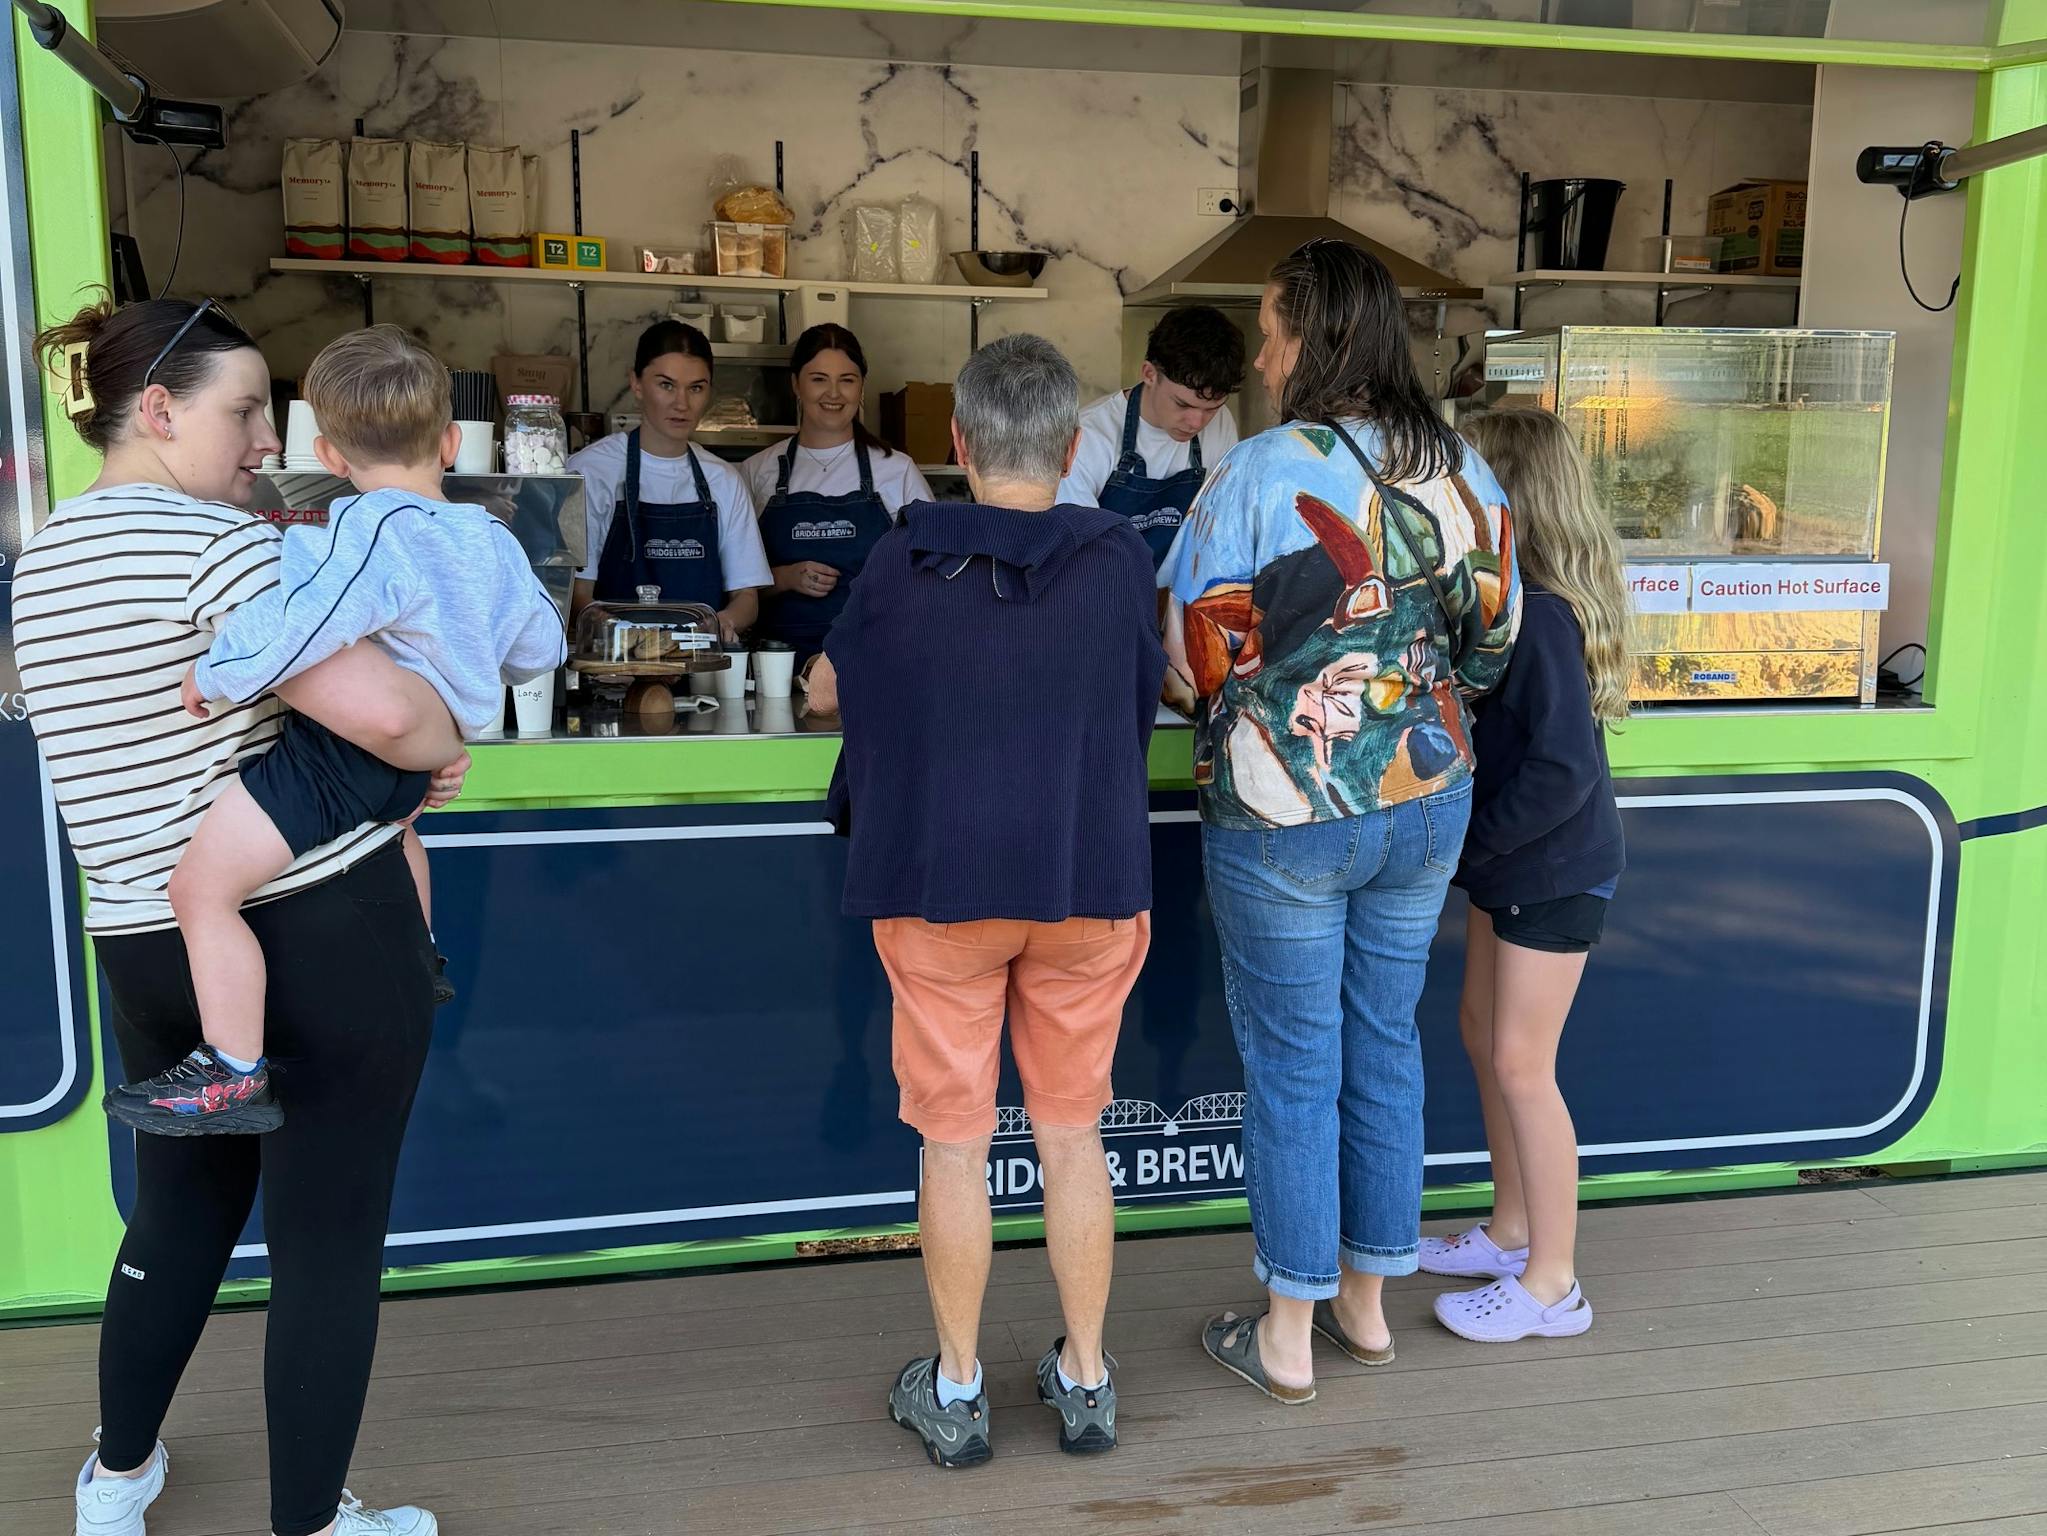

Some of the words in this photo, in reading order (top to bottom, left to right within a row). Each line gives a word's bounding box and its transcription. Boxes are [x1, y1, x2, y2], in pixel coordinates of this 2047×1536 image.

[289, 177, 323, 186] Memory
[355, 179, 388, 189] Memory
[416, 182, 448, 192] Memory
[476, 190, 511, 198] Memory
[548, 243, 564, 254] T2
[582, 246, 597, 257] T2
[795, 530, 821, 538] BRIDGE
[827, 528, 847, 537] BREW
[647, 548, 673, 557] BRIDGE
[678, 548, 695, 557] BREW
[1701, 580, 1771, 596] Caution
[1778, 579, 1809, 595] Hot
[1814, 578, 1881, 594] Surface
[518, 689, 543, 702] Large
[1137, 1143, 1245, 1186] BREW
